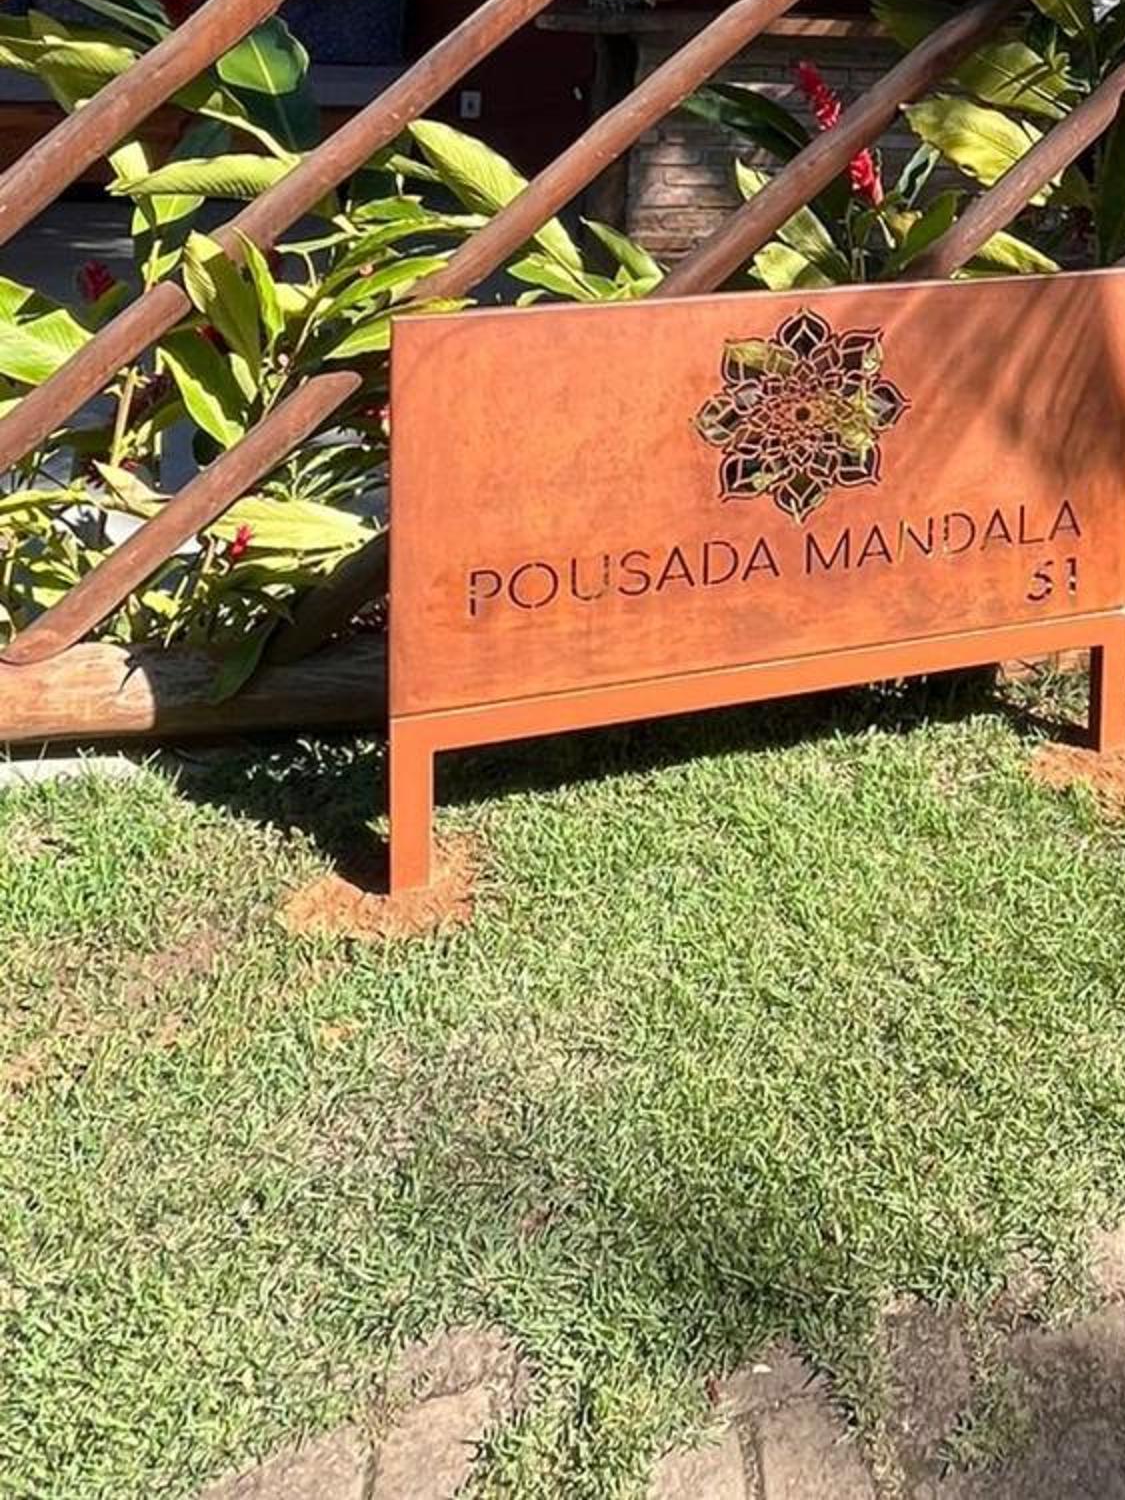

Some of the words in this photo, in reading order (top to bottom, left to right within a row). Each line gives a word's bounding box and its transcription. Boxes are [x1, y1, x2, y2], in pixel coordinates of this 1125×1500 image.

[469, 537, 780, 616] POUSADA
[805, 499, 1082, 574] MANDALA
[1026, 557, 1077, 602] 51
